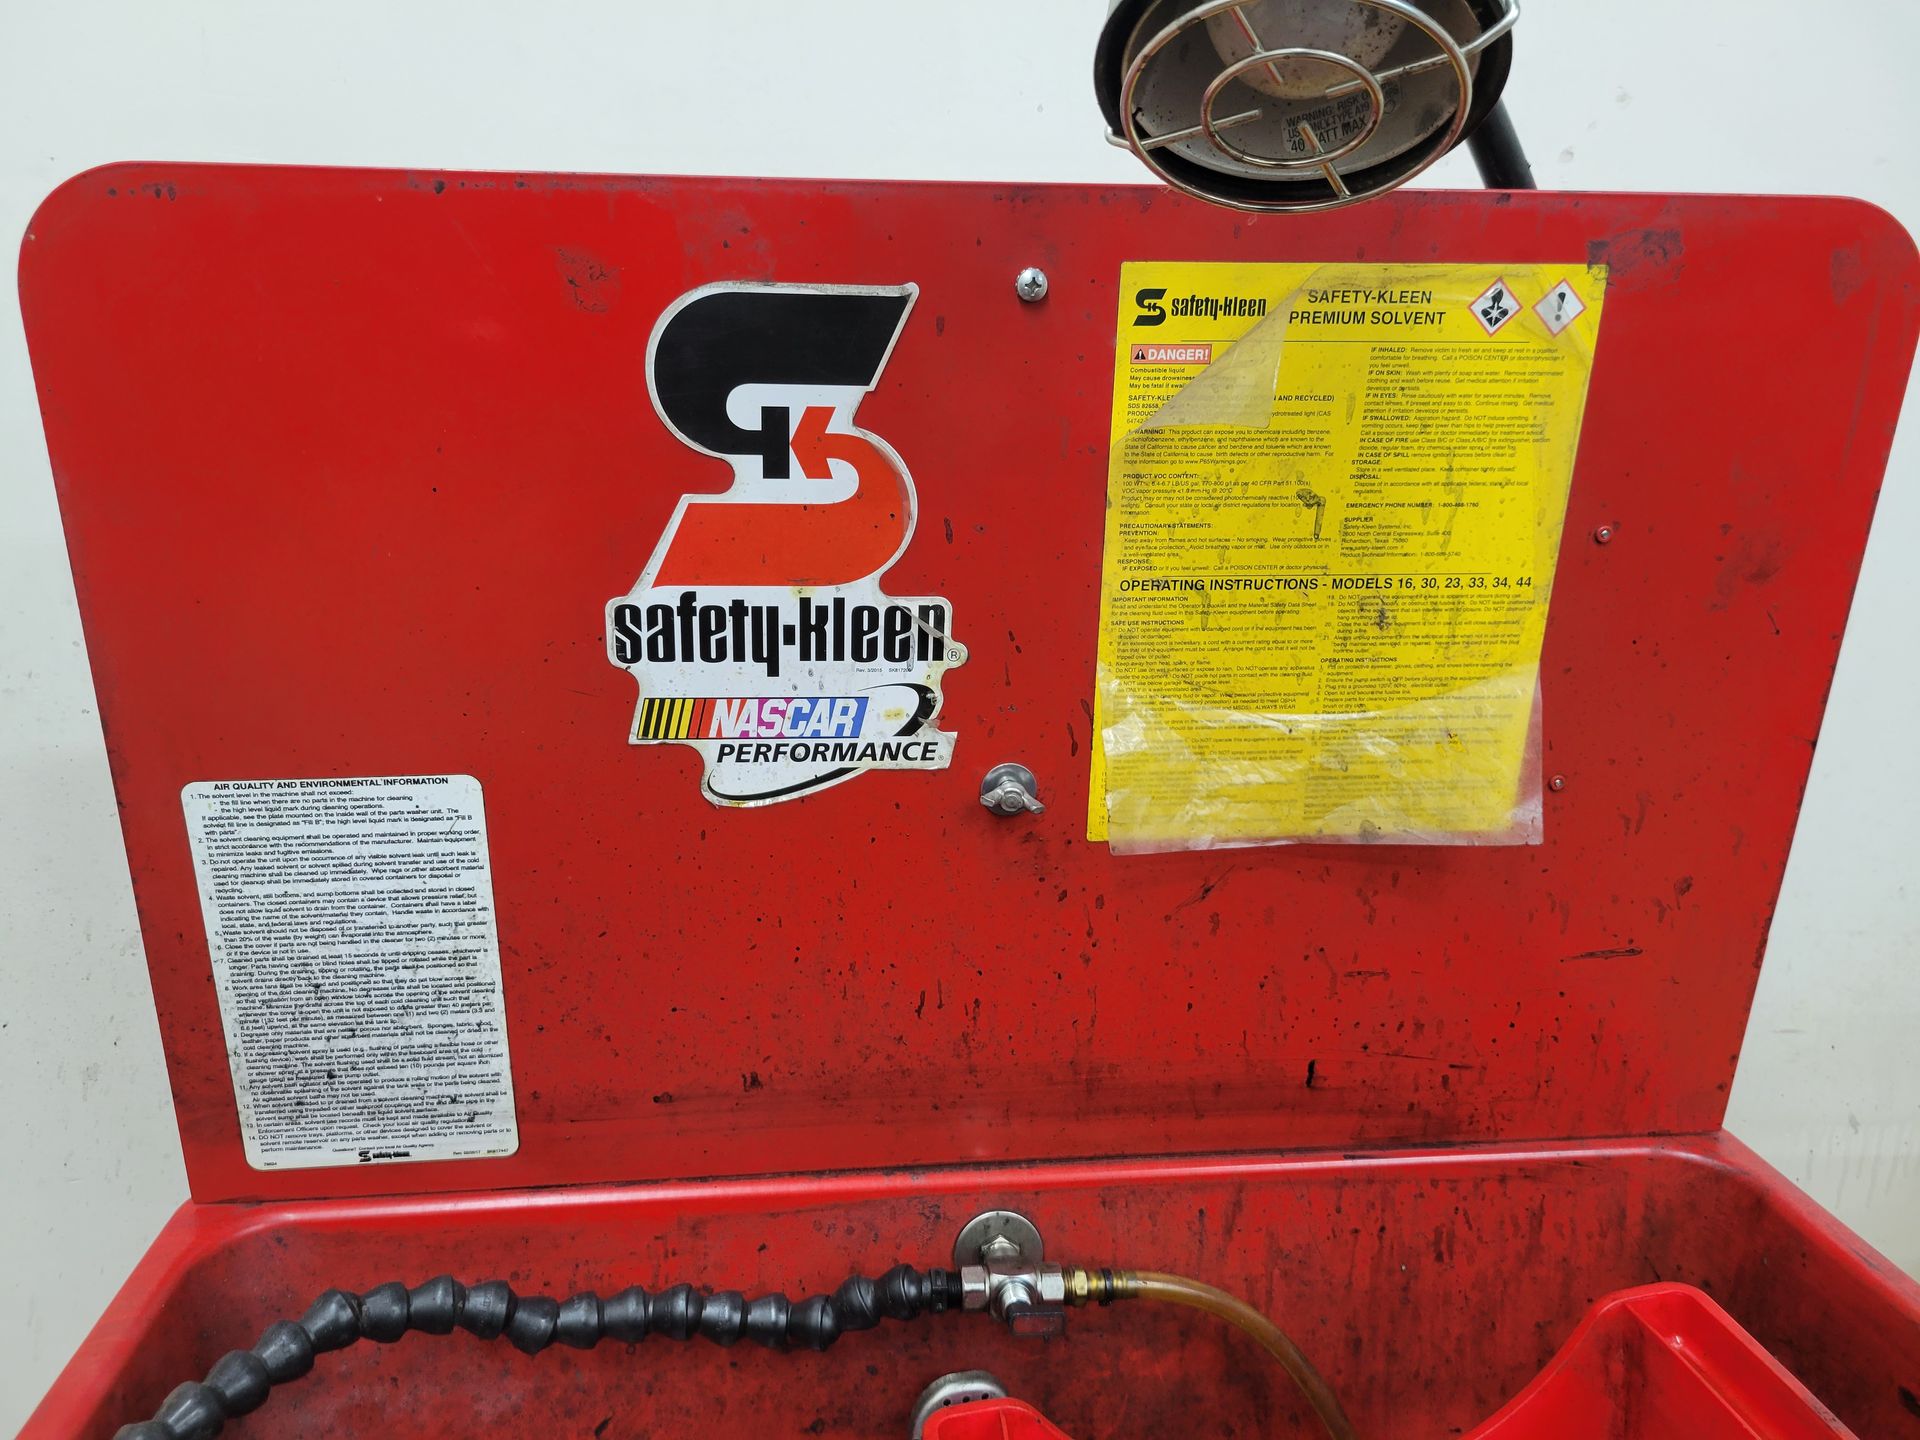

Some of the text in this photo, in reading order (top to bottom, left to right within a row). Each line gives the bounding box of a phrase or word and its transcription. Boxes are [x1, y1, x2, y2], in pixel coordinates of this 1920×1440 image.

[1290, 138, 1306, 153] 40
[1342, 115, 1368, 136] MAX
[1308, 290, 1432, 304] SAFETY-KLEEN
[1288, 310, 1446, 325] PREMIUM SOLVENT
[1148, 348, 1209, 361] DANGER!
[1119, 579, 1205, 591] OPERATING
[1209, 578, 1319, 590] INSTRUCTIONS
[1331, 577, 1393, 589] MODELS
[1396, 577, 1417, 590] 16,
[1420, 577, 1440, 589] 30,
[1444, 577, 1464, 589] 23,
[1467, 576, 1488, 588] 33,
[1492, 576, 1512, 588] 34,
[1515, 576, 1532, 587] 44
[708, 698, 858, 738] NASCAR
[716, 742, 938, 763] PERFORMANCE
[232, 782, 274, 790] QUALITY
[299, 779, 383, 788] ENVIRONMENTAL
[383, 777, 448, 786] INFORMATION
